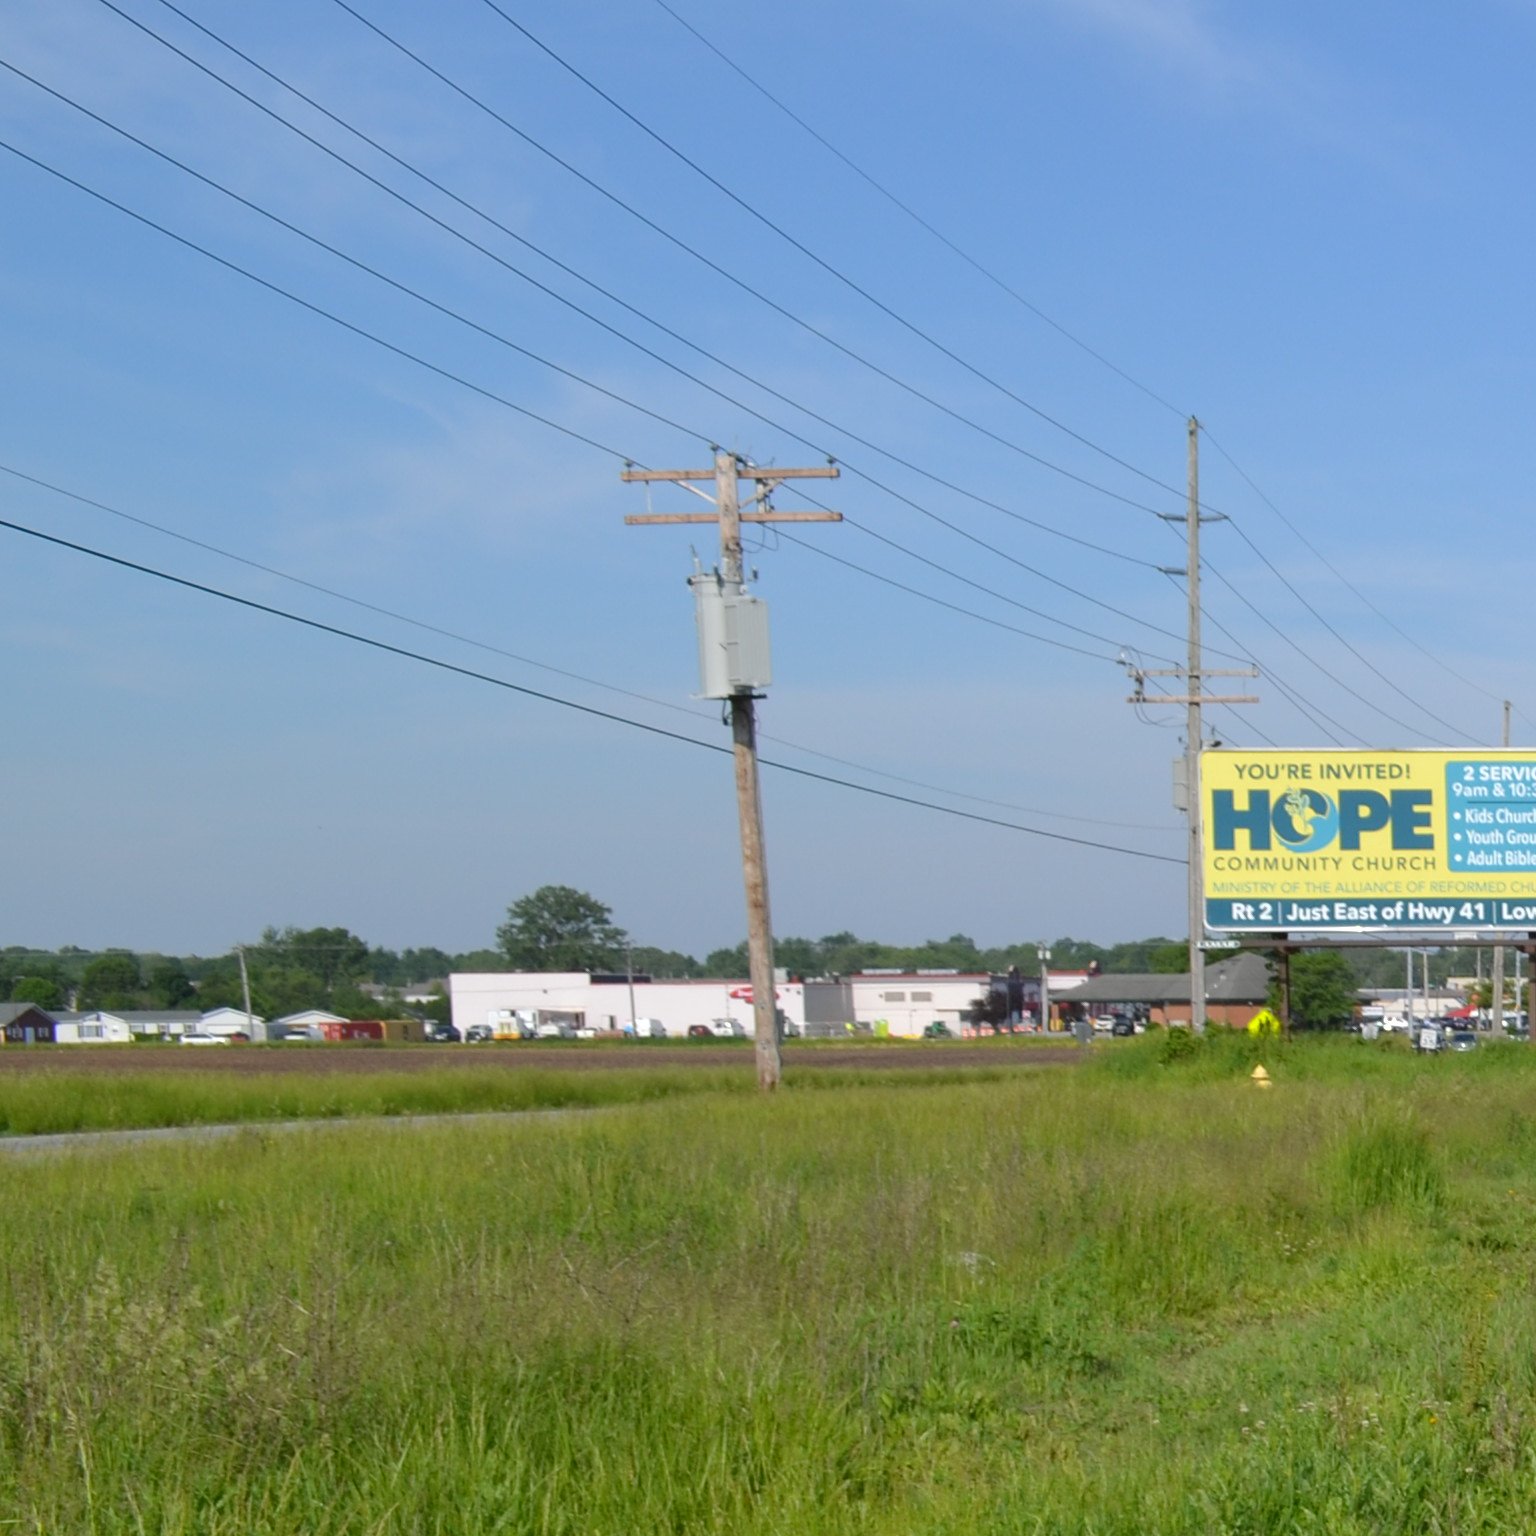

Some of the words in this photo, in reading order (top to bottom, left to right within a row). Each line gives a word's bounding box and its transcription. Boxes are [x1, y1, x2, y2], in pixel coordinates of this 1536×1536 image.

[1234, 763, 1312, 780] YOU'RE
[1320, 763, 1411, 780] INVITED!
[1463, 765, 1475, 781] 2
[1452, 782, 1488, 797] 9am
[1492, 782, 1505, 797] &
[1212, 787, 1435, 853] HOPE
[1465, 808, 1493, 823] Kids
[1466, 829, 1504, 845] Youth
[1213, 856, 1343, 871] COMMUNITY
[1352, 856, 1436, 871] CHURCH
[1467, 850, 1503, 866] Adult
[1213, 881, 1277, 893] MINISTRY
[1281, 881, 1300, 893] OF
[1306, 881, 1331, 893] THE
[1335, 881, 1402, 893] ALLIANCE
[1406, 881, 1426, 893] OF
[1430, 881, 1506, 893] REFORMED
[1231, 902, 1255, 920] Rt
[1259, 902, 1273, 920] 2
[1286, 902, 1330, 921] Just
[1334, 902, 1377, 920] East
[1381, 902, 1404, 920] of
[1408, 902, 1455, 924] Hwy
[1459, 902, 1485, 920] 41
